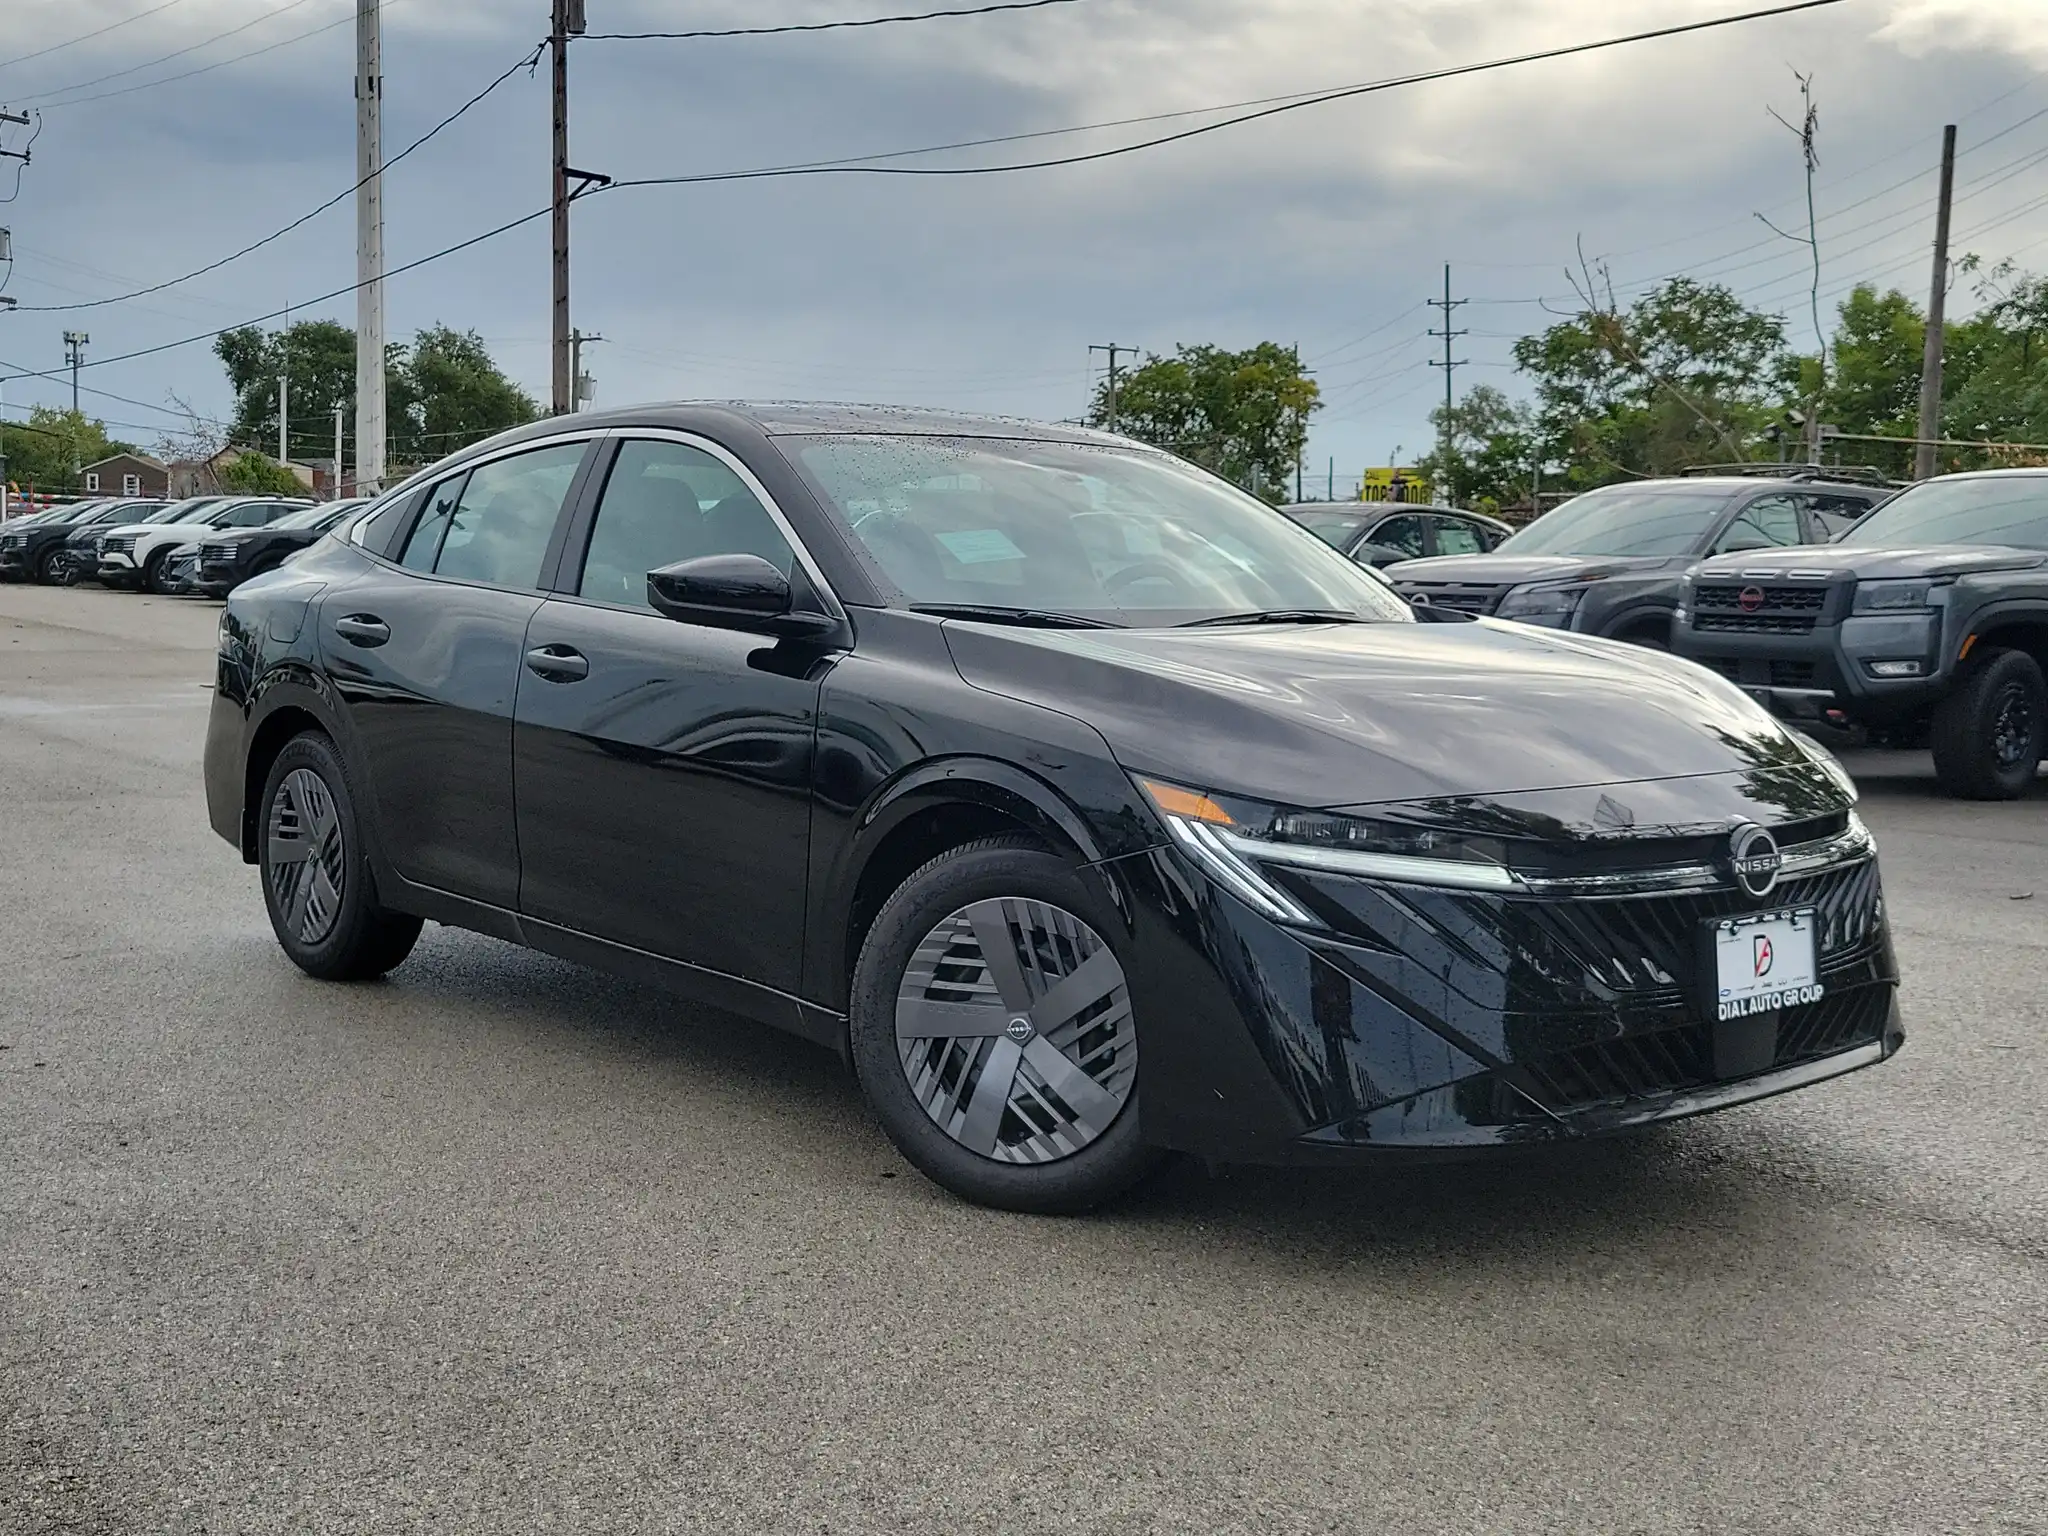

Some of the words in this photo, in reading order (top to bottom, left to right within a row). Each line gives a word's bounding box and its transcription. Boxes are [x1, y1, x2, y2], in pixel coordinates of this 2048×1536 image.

[1718, 1001, 1748, 1021] DIAL
[1749, 993, 1781, 1014] AUTO
[1783, 984, 1824, 1006] GROUP
